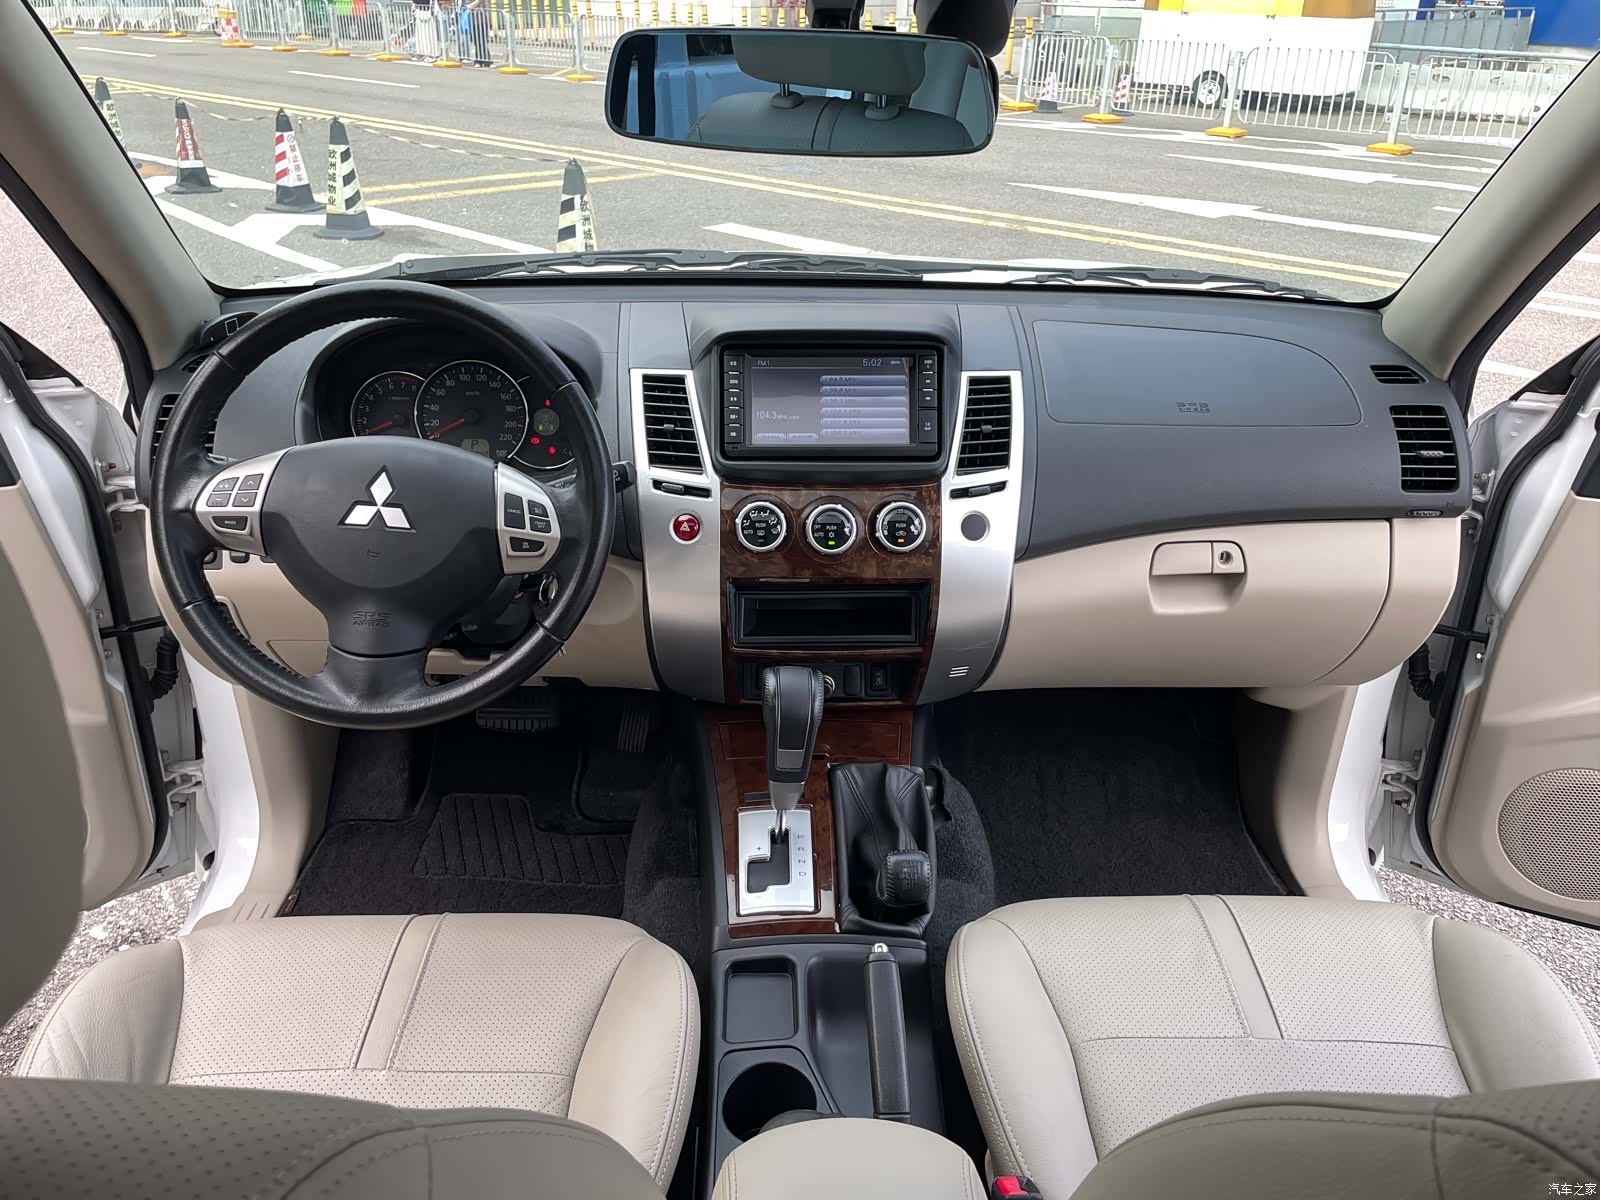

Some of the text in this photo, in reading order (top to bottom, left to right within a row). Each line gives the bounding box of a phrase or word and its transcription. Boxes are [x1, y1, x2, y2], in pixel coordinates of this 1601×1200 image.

[328, 149, 337, 206] 欧洲城物业
[436, 388, 446, 396] 60
[500, 393, 512, 401] 160
[505, 405, 517, 413] 180
[504, 420, 518, 428] 200
[499, 433, 513, 441] 220
